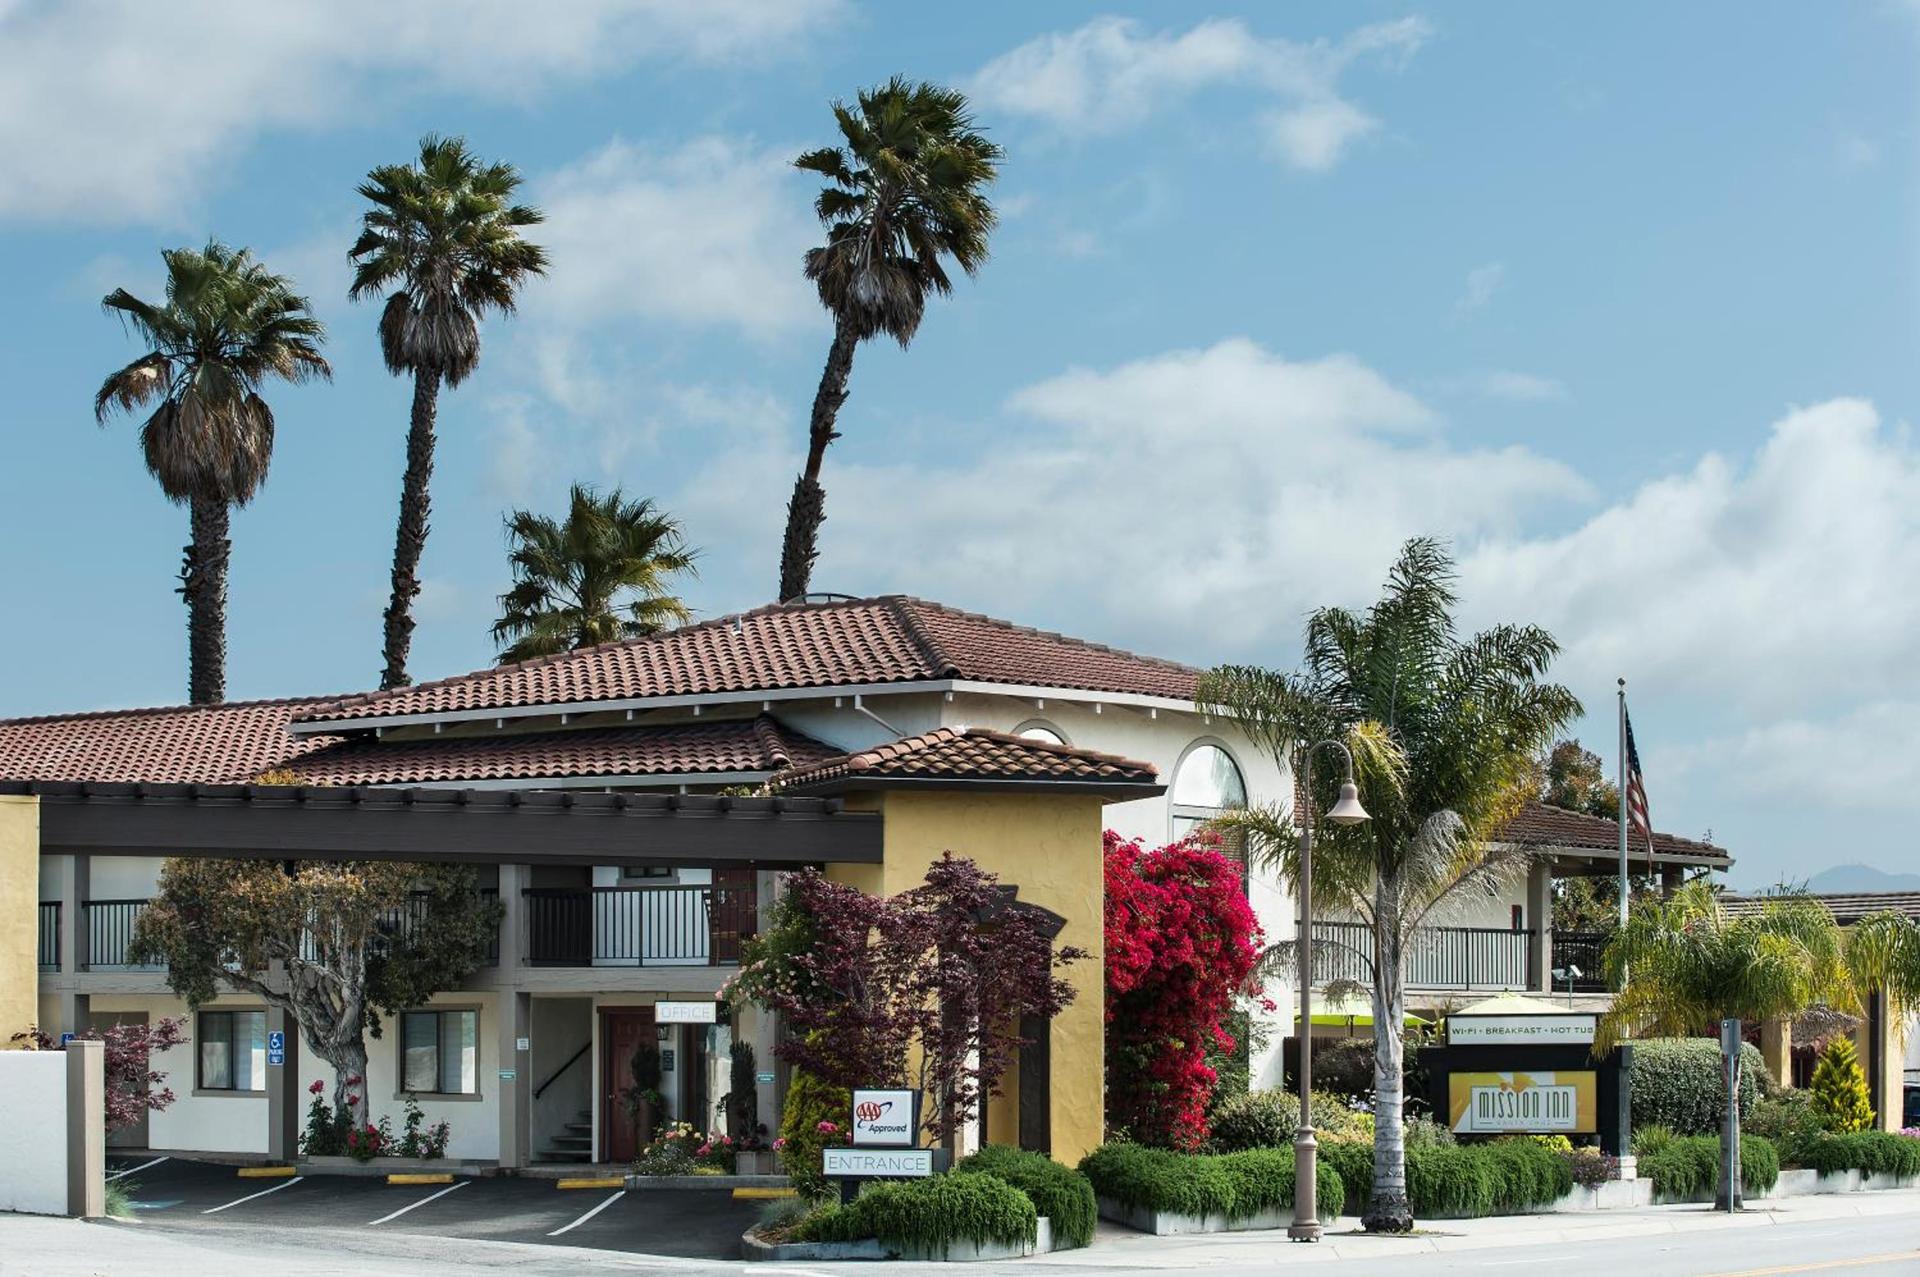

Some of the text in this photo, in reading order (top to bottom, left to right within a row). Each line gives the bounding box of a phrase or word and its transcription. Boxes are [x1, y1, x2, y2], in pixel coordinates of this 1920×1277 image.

[661, 1006, 710, 1018] OFFICE
[1485, 1026, 1542, 1035] BREAKFAST
[1551, 1026, 1571, 1034] HOT
[1574, 1026, 1594, 1034] TUB
[859, 1102, 880, 1120] AAA
[1479, 1091, 1570, 1119] MISSION INN
[868, 1123, 907, 1134] Approved
[828, 1156, 926, 1171] ENTRANCE
